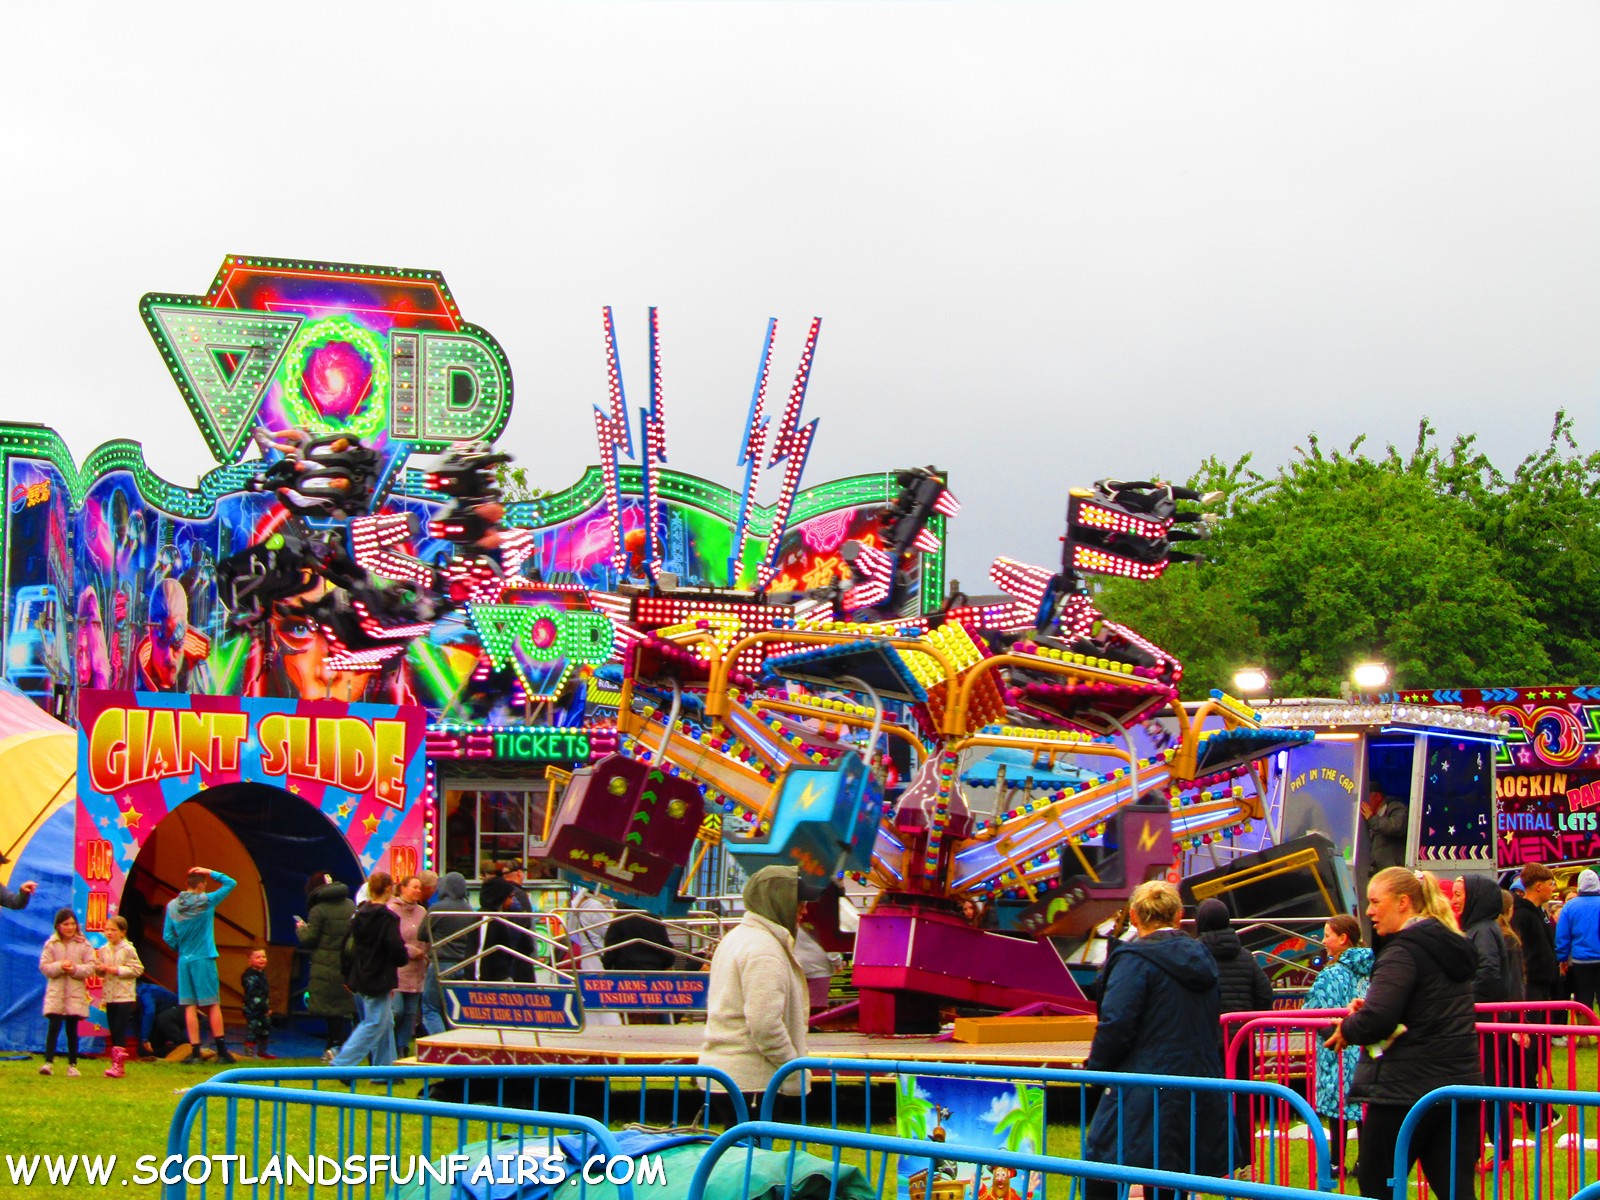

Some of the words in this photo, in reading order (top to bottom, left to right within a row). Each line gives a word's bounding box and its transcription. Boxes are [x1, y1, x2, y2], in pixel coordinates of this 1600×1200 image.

[150, 304, 507, 460] VOID
[470, 602, 614, 673] VOID
[88, 705, 249, 795] GIANT
[256, 712, 408, 811] SLIDE
[494, 733, 590, 758] TICKETS
[1290, 772, 1306, 792] PAY
[1309, 768, 1318, 781] IN
[1321, 767, 1338, 781] THE
[1338, 773, 1355, 794] CAR
[1496, 772, 1568, 799] ROCKIN
[1558, 812, 1598, 831] LETS
[87, 839, 113, 883] FOR
[391, 845, 417, 884] FOR
[468, 991, 499, 1005] PLEASE
[499, 992, 524, 1006] STAND
[525, 993, 552, 1007] CLEAR
[584, 979, 614, 991] KEEP
[617, 980, 648, 991] ARMS
[650, 980, 674, 991] AND
[676, 980, 704, 992] LEGS
[599, 992, 638, 1004] INSIDE
[640, 992, 663, 1004] THE
[665, 993, 693, 1004] CARS
[462, 1006, 491, 1019] WHILST
[493, 1008, 513, 1020] RIDE
[513, 1008, 522, 1021] IS
[523, 1009, 533, 1022] IN
[534, 1010, 565, 1023] MOTION
